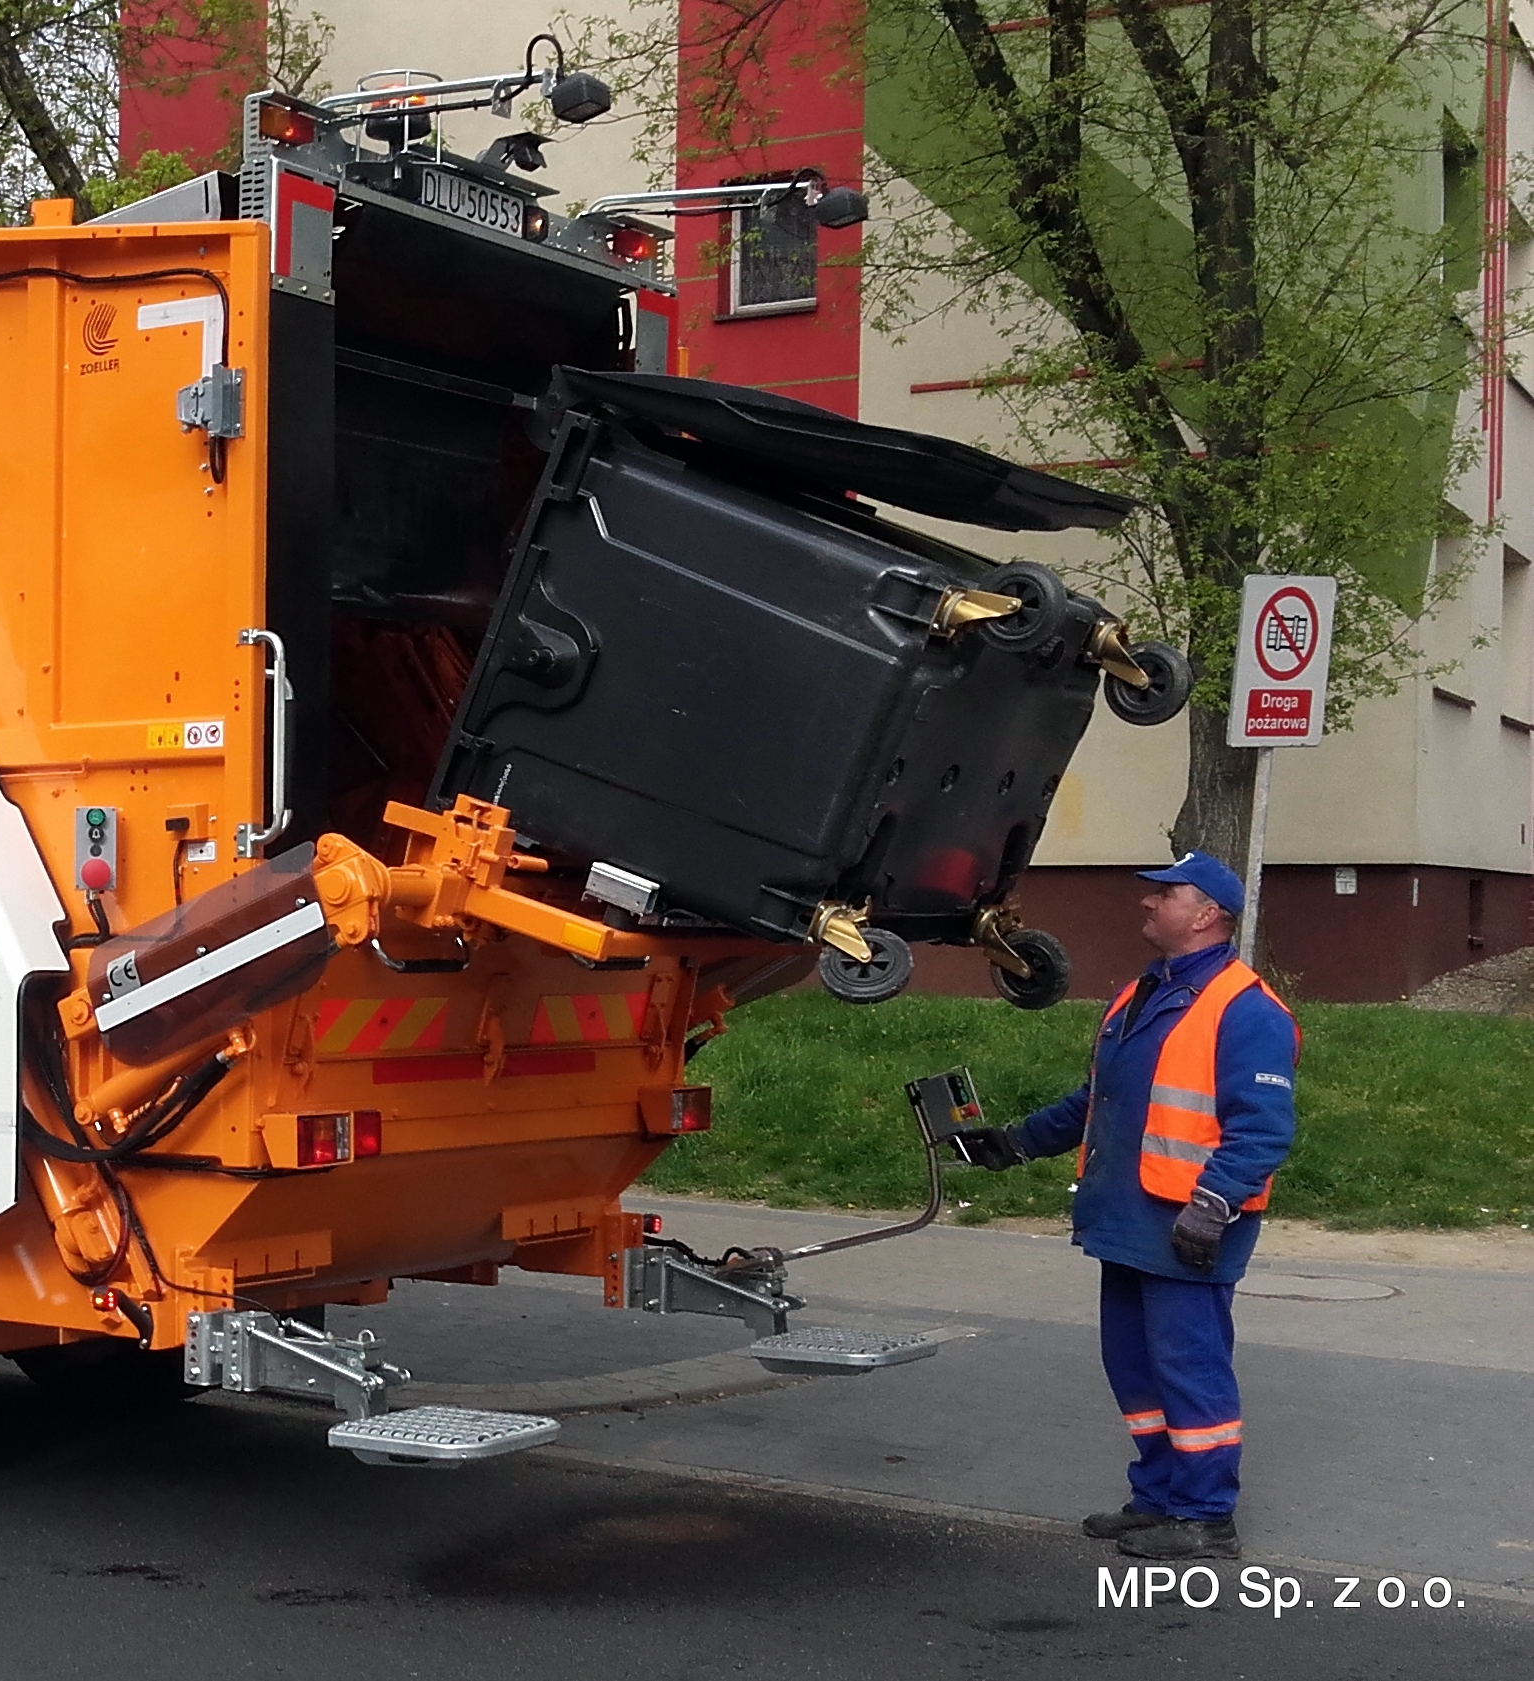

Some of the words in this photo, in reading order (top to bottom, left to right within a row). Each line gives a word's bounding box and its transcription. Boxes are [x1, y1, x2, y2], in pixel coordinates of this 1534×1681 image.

[424, 171, 462, 213] DLU
[466, 184, 521, 233] 50553
[79, 358, 120, 376] ZOELLER
[1260, 692, 1299, 712] Droga
[1247, 713, 1307, 733] pożarowa
